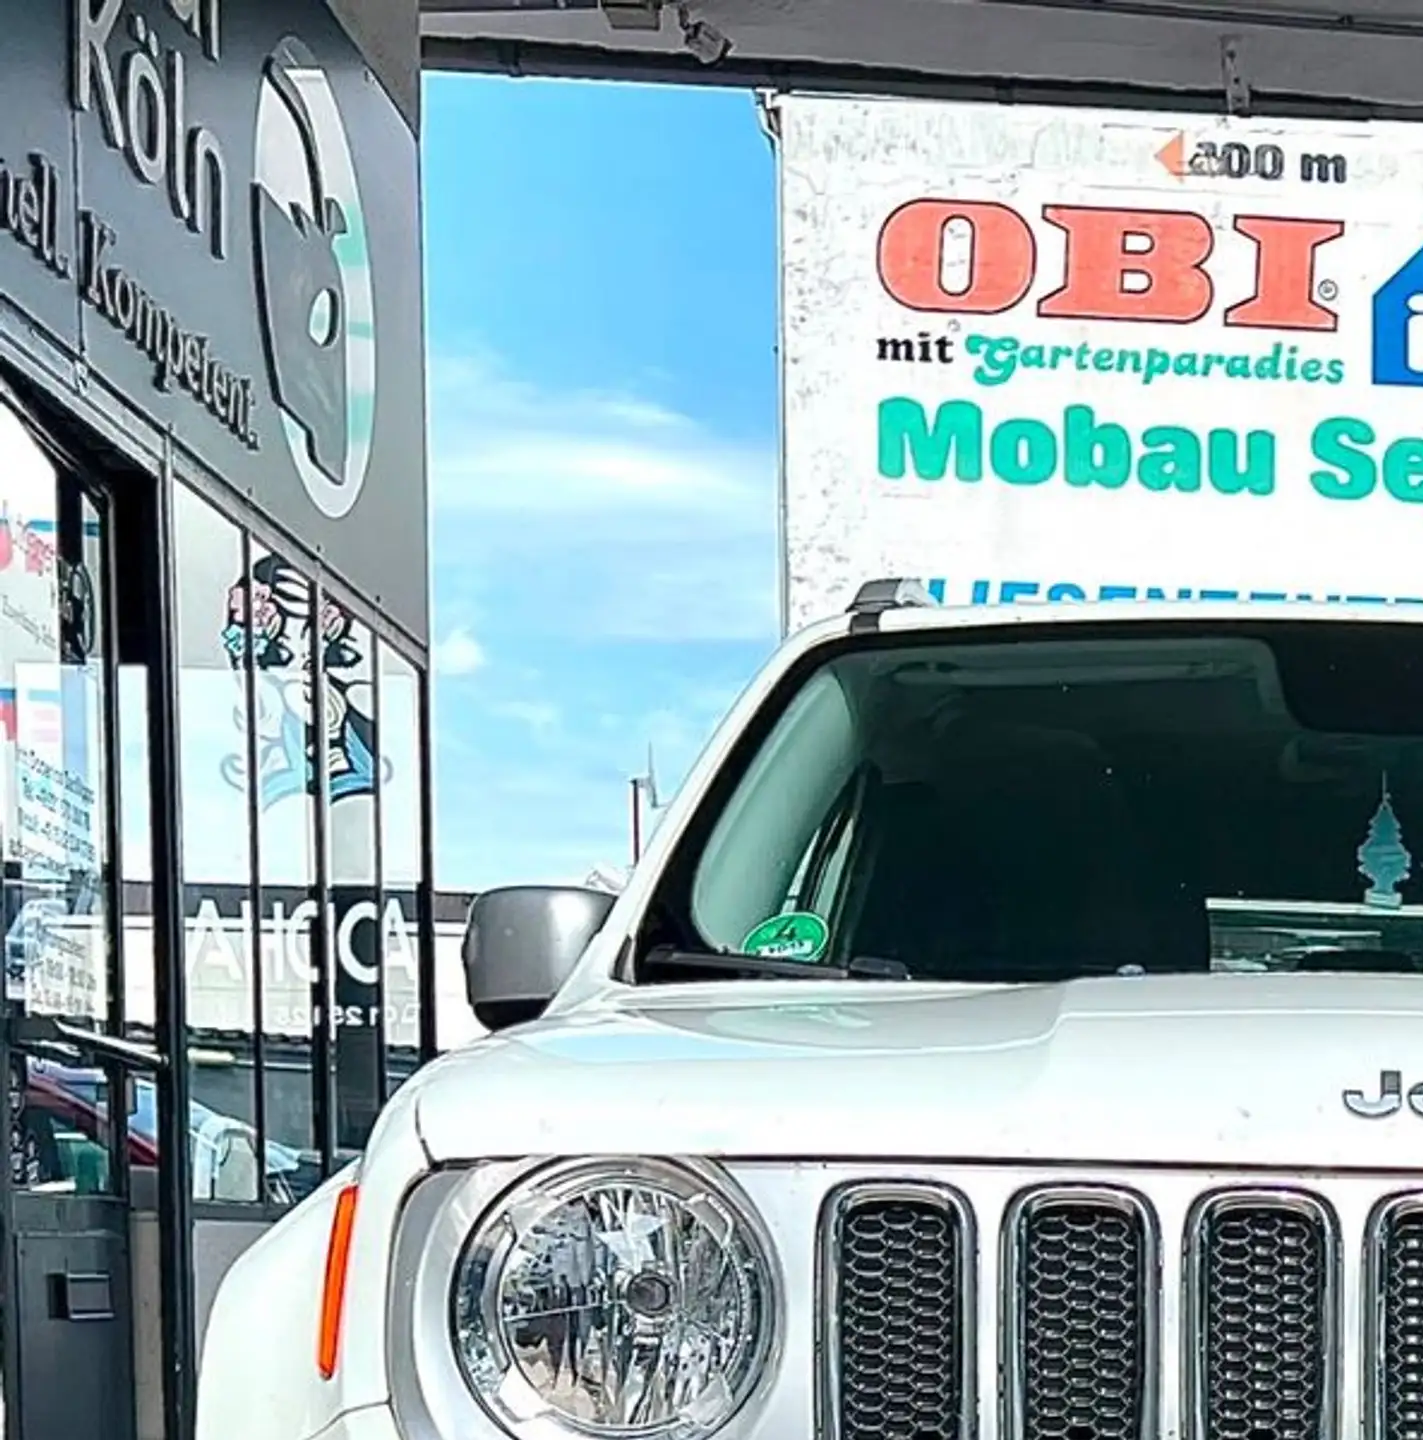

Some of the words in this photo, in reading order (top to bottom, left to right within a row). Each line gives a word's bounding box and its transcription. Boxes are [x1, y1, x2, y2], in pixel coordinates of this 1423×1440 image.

[74, 0, 226, 260] Köln
[1300, 153, 1347, 183] m
[876, 197, 1345, 332] OBI
[876, 331, 954, 363] mit
[964, 333, 1346, 386] Gartenparadies
[877, 395, 1277, 497] Mobau
